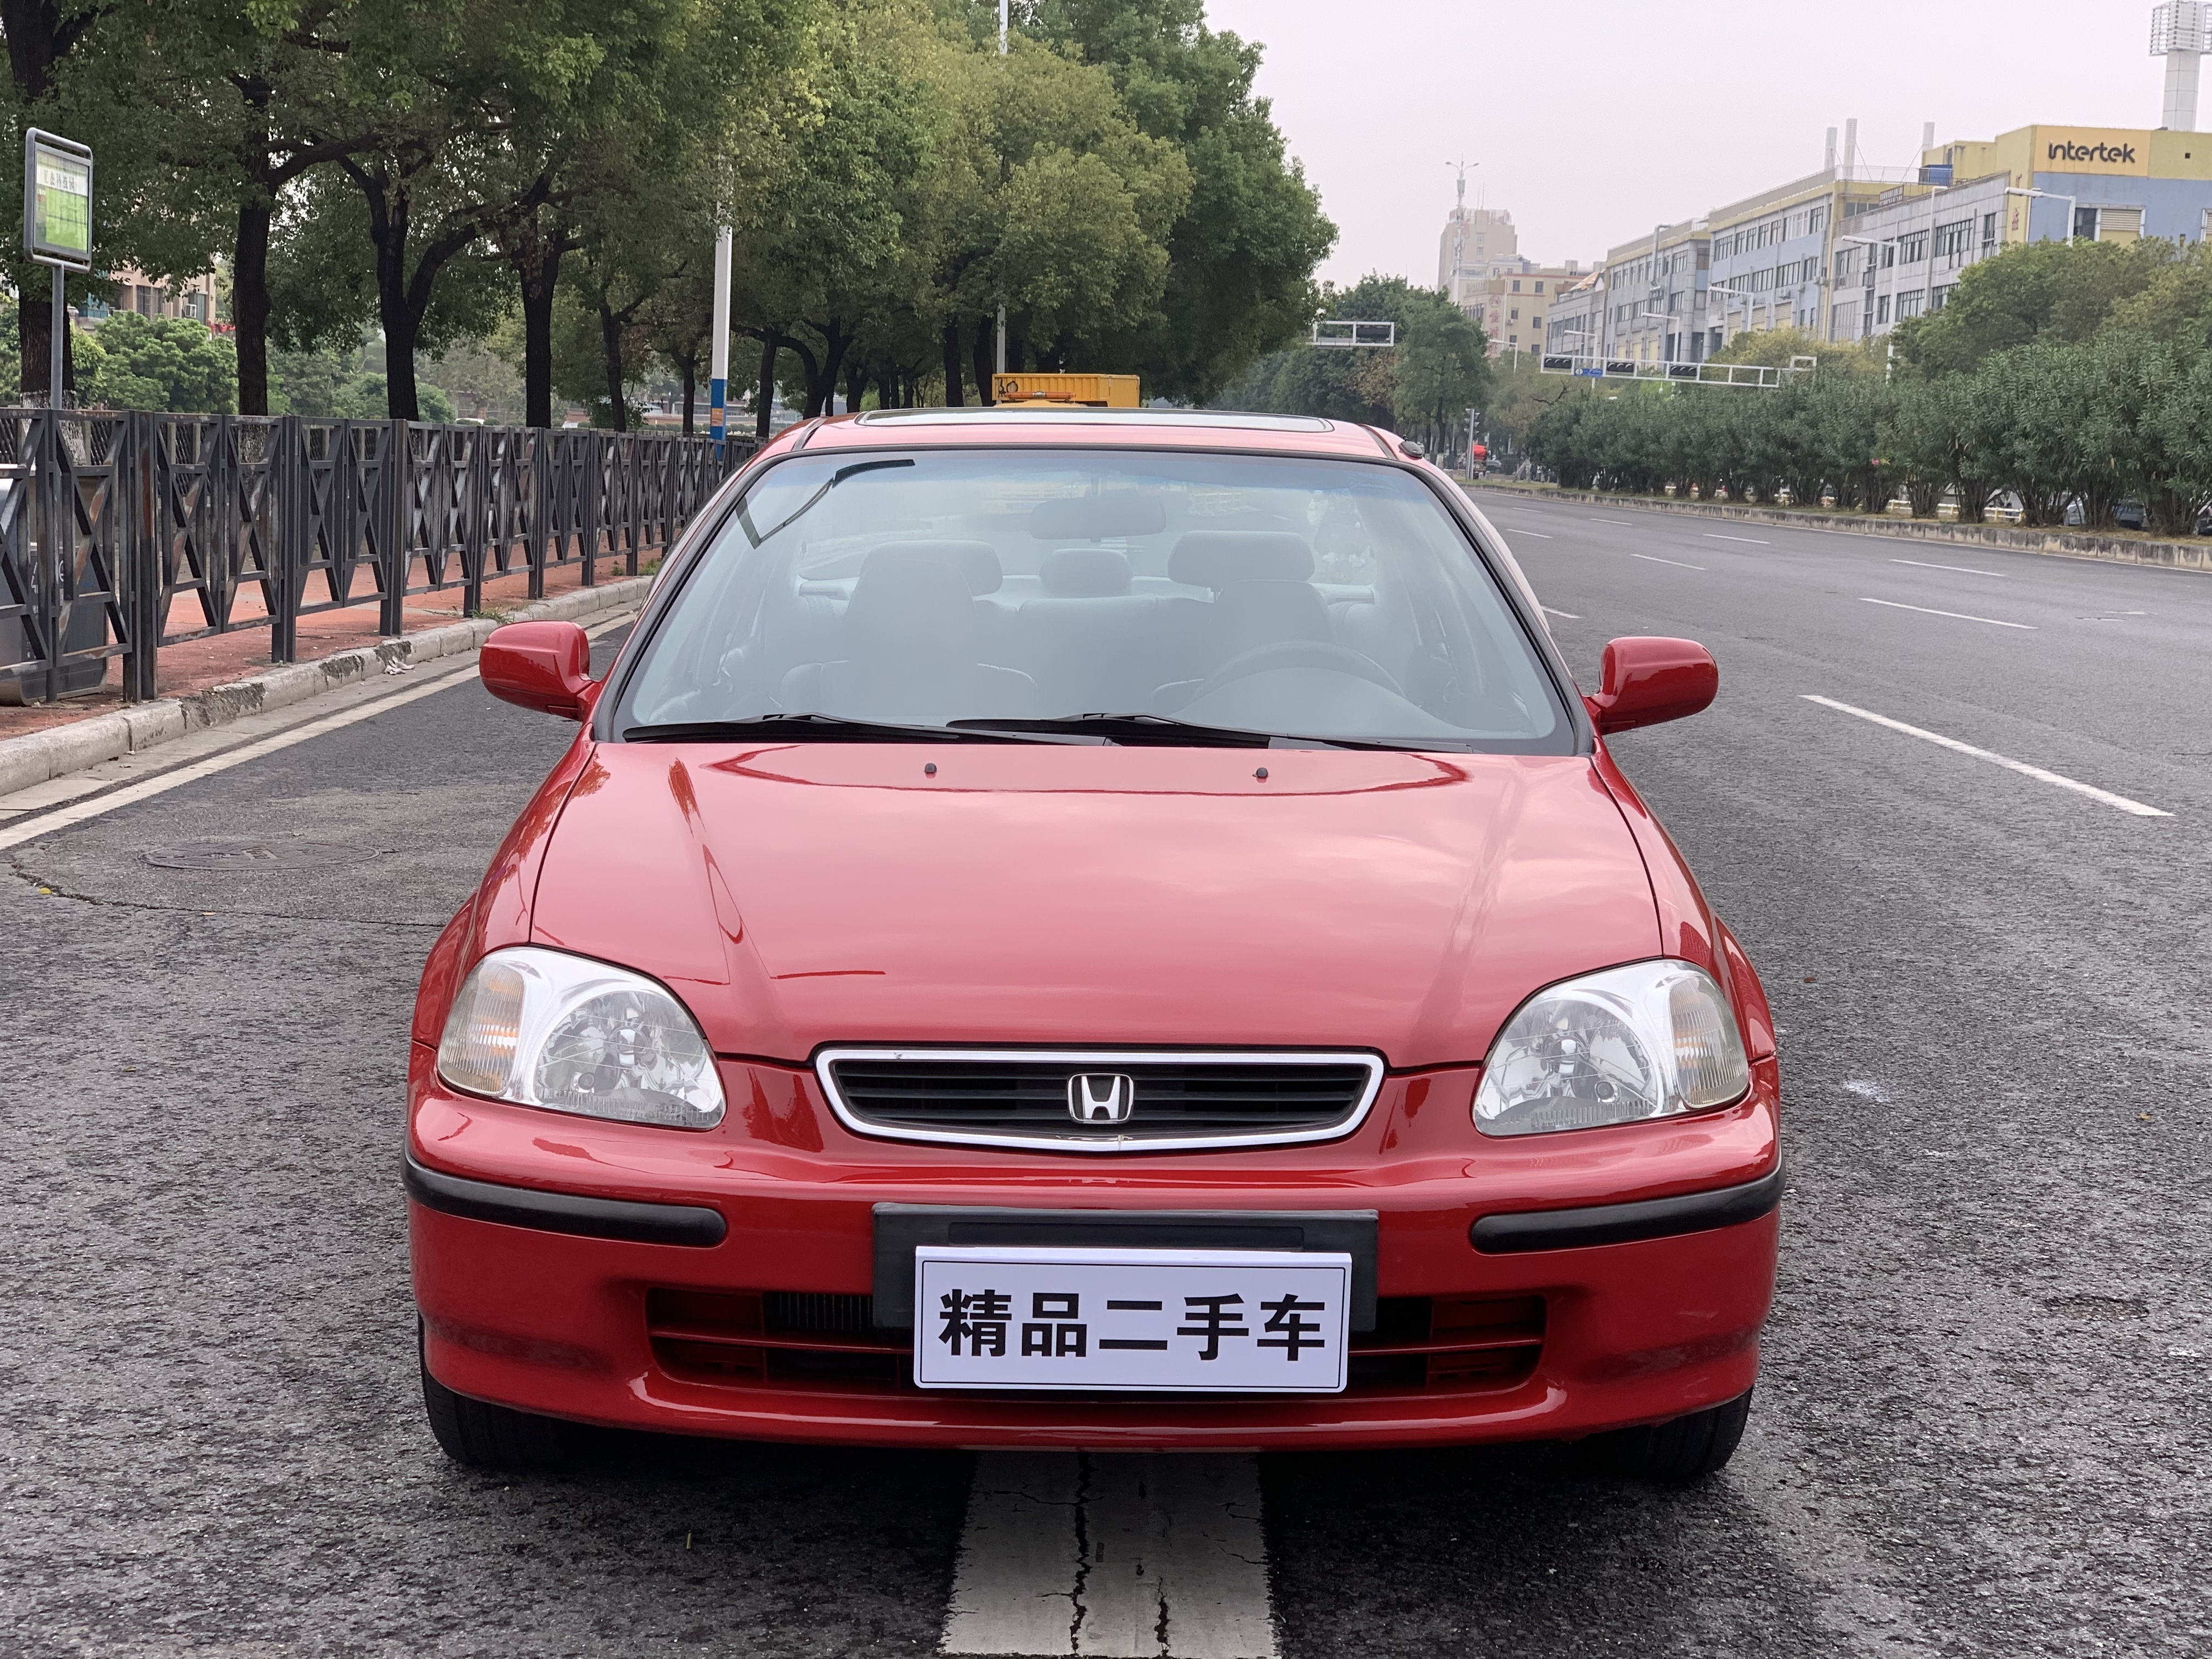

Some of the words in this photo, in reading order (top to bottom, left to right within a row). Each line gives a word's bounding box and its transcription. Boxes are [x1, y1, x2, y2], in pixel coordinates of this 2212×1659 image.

[2049, 139, 2136, 163] intertek
[938, 1288, 1325, 1362] 精品二手车
